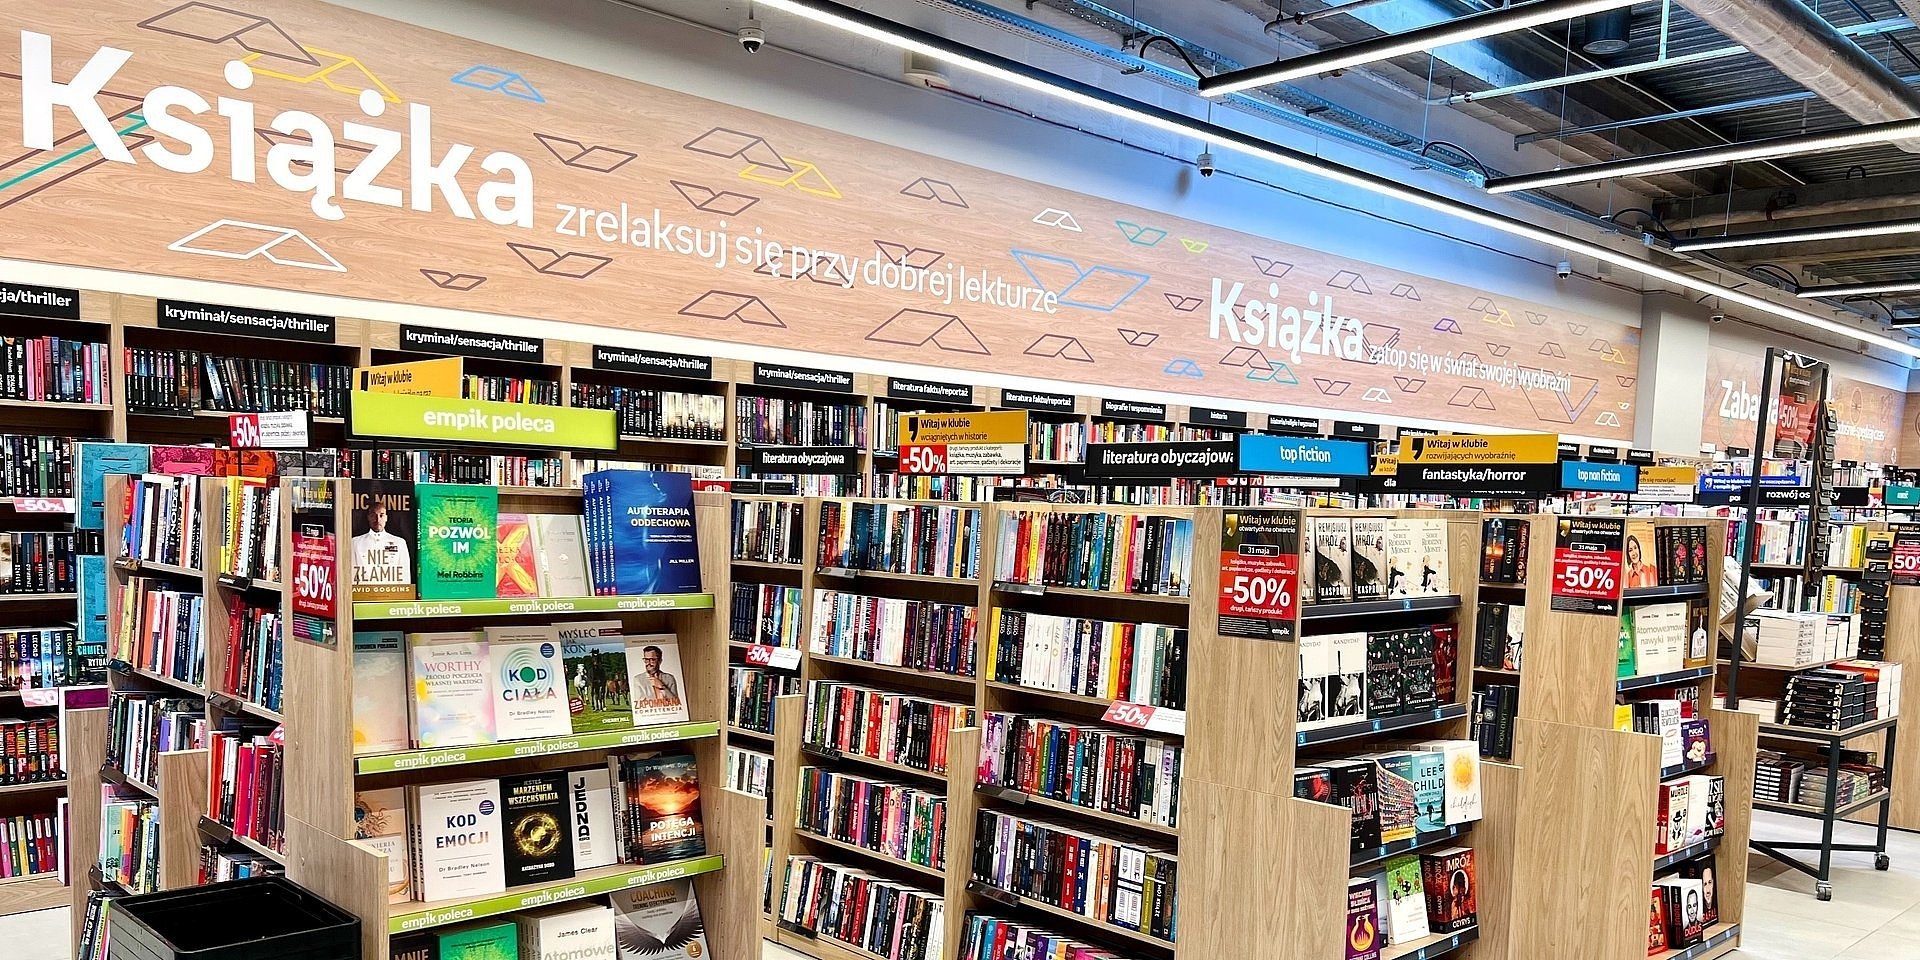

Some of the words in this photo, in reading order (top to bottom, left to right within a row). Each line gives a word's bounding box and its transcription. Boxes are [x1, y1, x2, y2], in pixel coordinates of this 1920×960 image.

[20, 29, 535, 229] Książka
[554, 202, 727, 269] zrelaksuj
[734, 227, 784, 278] się
[790, 249, 859, 289] przy
[863, 251, 954, 305] dobrej
[958, 269, 1058, 314] lekturze
[165, 305, 330, 333] kryminał/sensacja/thriller
[1209, 277, 1364, 364] Książka
[406, 330, 539, 353] kryminał/sensacja/thriller
[598, 350, 708, 371] kryminał/sensacja/thriller
[1368, 343, 1407, 369] zatop
[1409, 345, 1428, 376] się
[1430, 355, 1443, 373] w
[1444, 351, 1479, 377] świat
[1479, 360, 1518, 388] swojej
[1517, 366, 1571, 394] wyobraźni
[370, 371, 387, 385] Witaj
[393, 371, 412, 383] klubie
[758, 367, 850, 385] kryminał/sensacja/thriller
[893, 381, 923, 393] literatura
[923, 384, 969, 398] faktu/reportaż
[1719, 380, 1778, 425] Zabaa
[424, 408, 487, 431] empik
[493, 411, 555, 433] poleca
[921, 420, 940, 430] Witaj
[948, 419, 970, 428] klubie
[232, 415, 259, 447] -50%
[920, 433, 958, 442] wciągniętych
[964, 432, 987, 440] historie
[1427, 439, 1450, 450] Witaj
[1462, 439, 1488, 449] klubie
[762, 452, 797, 464] literatura
[798, 454, 844, 466] obyczajowa
[903, 447, 945, 473] -50%
[1103, 449, 1159, 465] literatura
[1280, 446, 1298, 463] top
[1299, 446, 1331, 463] fiction
[1426, 452, 1473, 461] rozwijających
[1475, 451, 1515, 460] wyobraźnię
[1423, 469, 1526, 482] fantastyka/horror
[1578, 469, 1588, 481] top
[1588, 472, 1599, 481] non
[1600, 469, 1620, 482] fiction
[1767, 490, 1798, 500] rozwój
[16, 500, 64, 511] -50%
[169, 480, 180, 535] LEGION
[627, 507, 690, 516] AUTOTERAPIA
[631, 519, 691, 527] ODDECHOWA
[1240, 515, 1261, 525] Witaj
[1271, 516, 1296, 525] klubie
[1572, 521, 1591, 529] Witaj
[1600, 522, 1620, 530] klubie
[429, 524, 491, 538] POZWÓL
[452, 541, 469, 553] IM
[1505, 538, 1513, 564] MIASTO
[368, 549, 388, 564] NIE
[354, 566, 403, 582] ZŁAMIE
[1556, 566, 1614, 590] -50%
[295, 563, 332, 601] -50%
[1224, 576, 1290, 607] -50%
[389, 604, 425, 617] empik
[426, 604, 461, 616] poleca
[510, 601, 541, 612] empik
[542, 600, 574, 611] poleca
[618, 598, 645, 609] empik
[646, 598, 675, 608] poleca
[559, 628, 596, 640] MYŚLEĆ
[1271, 627, 1289, 635] empik
[1334, 637, 1360, 645] KANDYDAT
[1640, 637, 1664, 646] nawyki
[564, 644, 587, 654] KOŃ
[748, 645, 770, 662] -50%
[424, 660, 482, 672] WORTHY
[509, 666, 547, 683] KOD
[503, 687, 557, 701] CIAŁA
[634, 698, 681, 709] ZAPOMNIANA
[635, 706, 683, 714] KOMPETENCJA
[1109, 705, 1148, 727] -50%
[1436, 710, 1441, 718] 5
[1500, 712, 1508, 729] LATO
[622, 732, 650, 744] empik
[650, 730, 680, 741] poleca
[1299, 735, 1304, 743] 3
[1498, 730, 1506, 748] NOCY
[514, 742, 546, 756] empik
[547, 741, 579, 752] poleca
[394, 755, 430, 768] empik
[430, 752, 466, 765] poleca
[1067, 745, 1075, 774] MATILDE
[1421, 766, 1437, 777] LEE
[513, 784, 552, 796] MARZENIEM
[1414, 778, 1444, 792] CHILD
[508, 791, 559, 805] WSZECHŚWIATA
[446, 814, 476, 828] KOD
[650, 817, 694, 831] POTĘGA
[651, 827, 696, 841] INTENCJI
[1450, 826, 1456, 834] 10
[436, 831, 489, 849] EMOCJI
[1446, 854, 1471, 871] MRÓZ
[627, 872, 655, 885] empik
[656, 866, 685, 882] poleca
[521, 892, 552, 906] empik
[553, 887, 585, 902] poleca
[401, 913, 437, 928] empik
[438, 908, 473, 924] poleca
[557, 928, 579, 938] James
[581, 926, 598, 935] Clear
[1452, 937, 1458, 945] 15
[543, 943, 615, 960] Atomowe
[1418, 951, 1425, 959] 14
